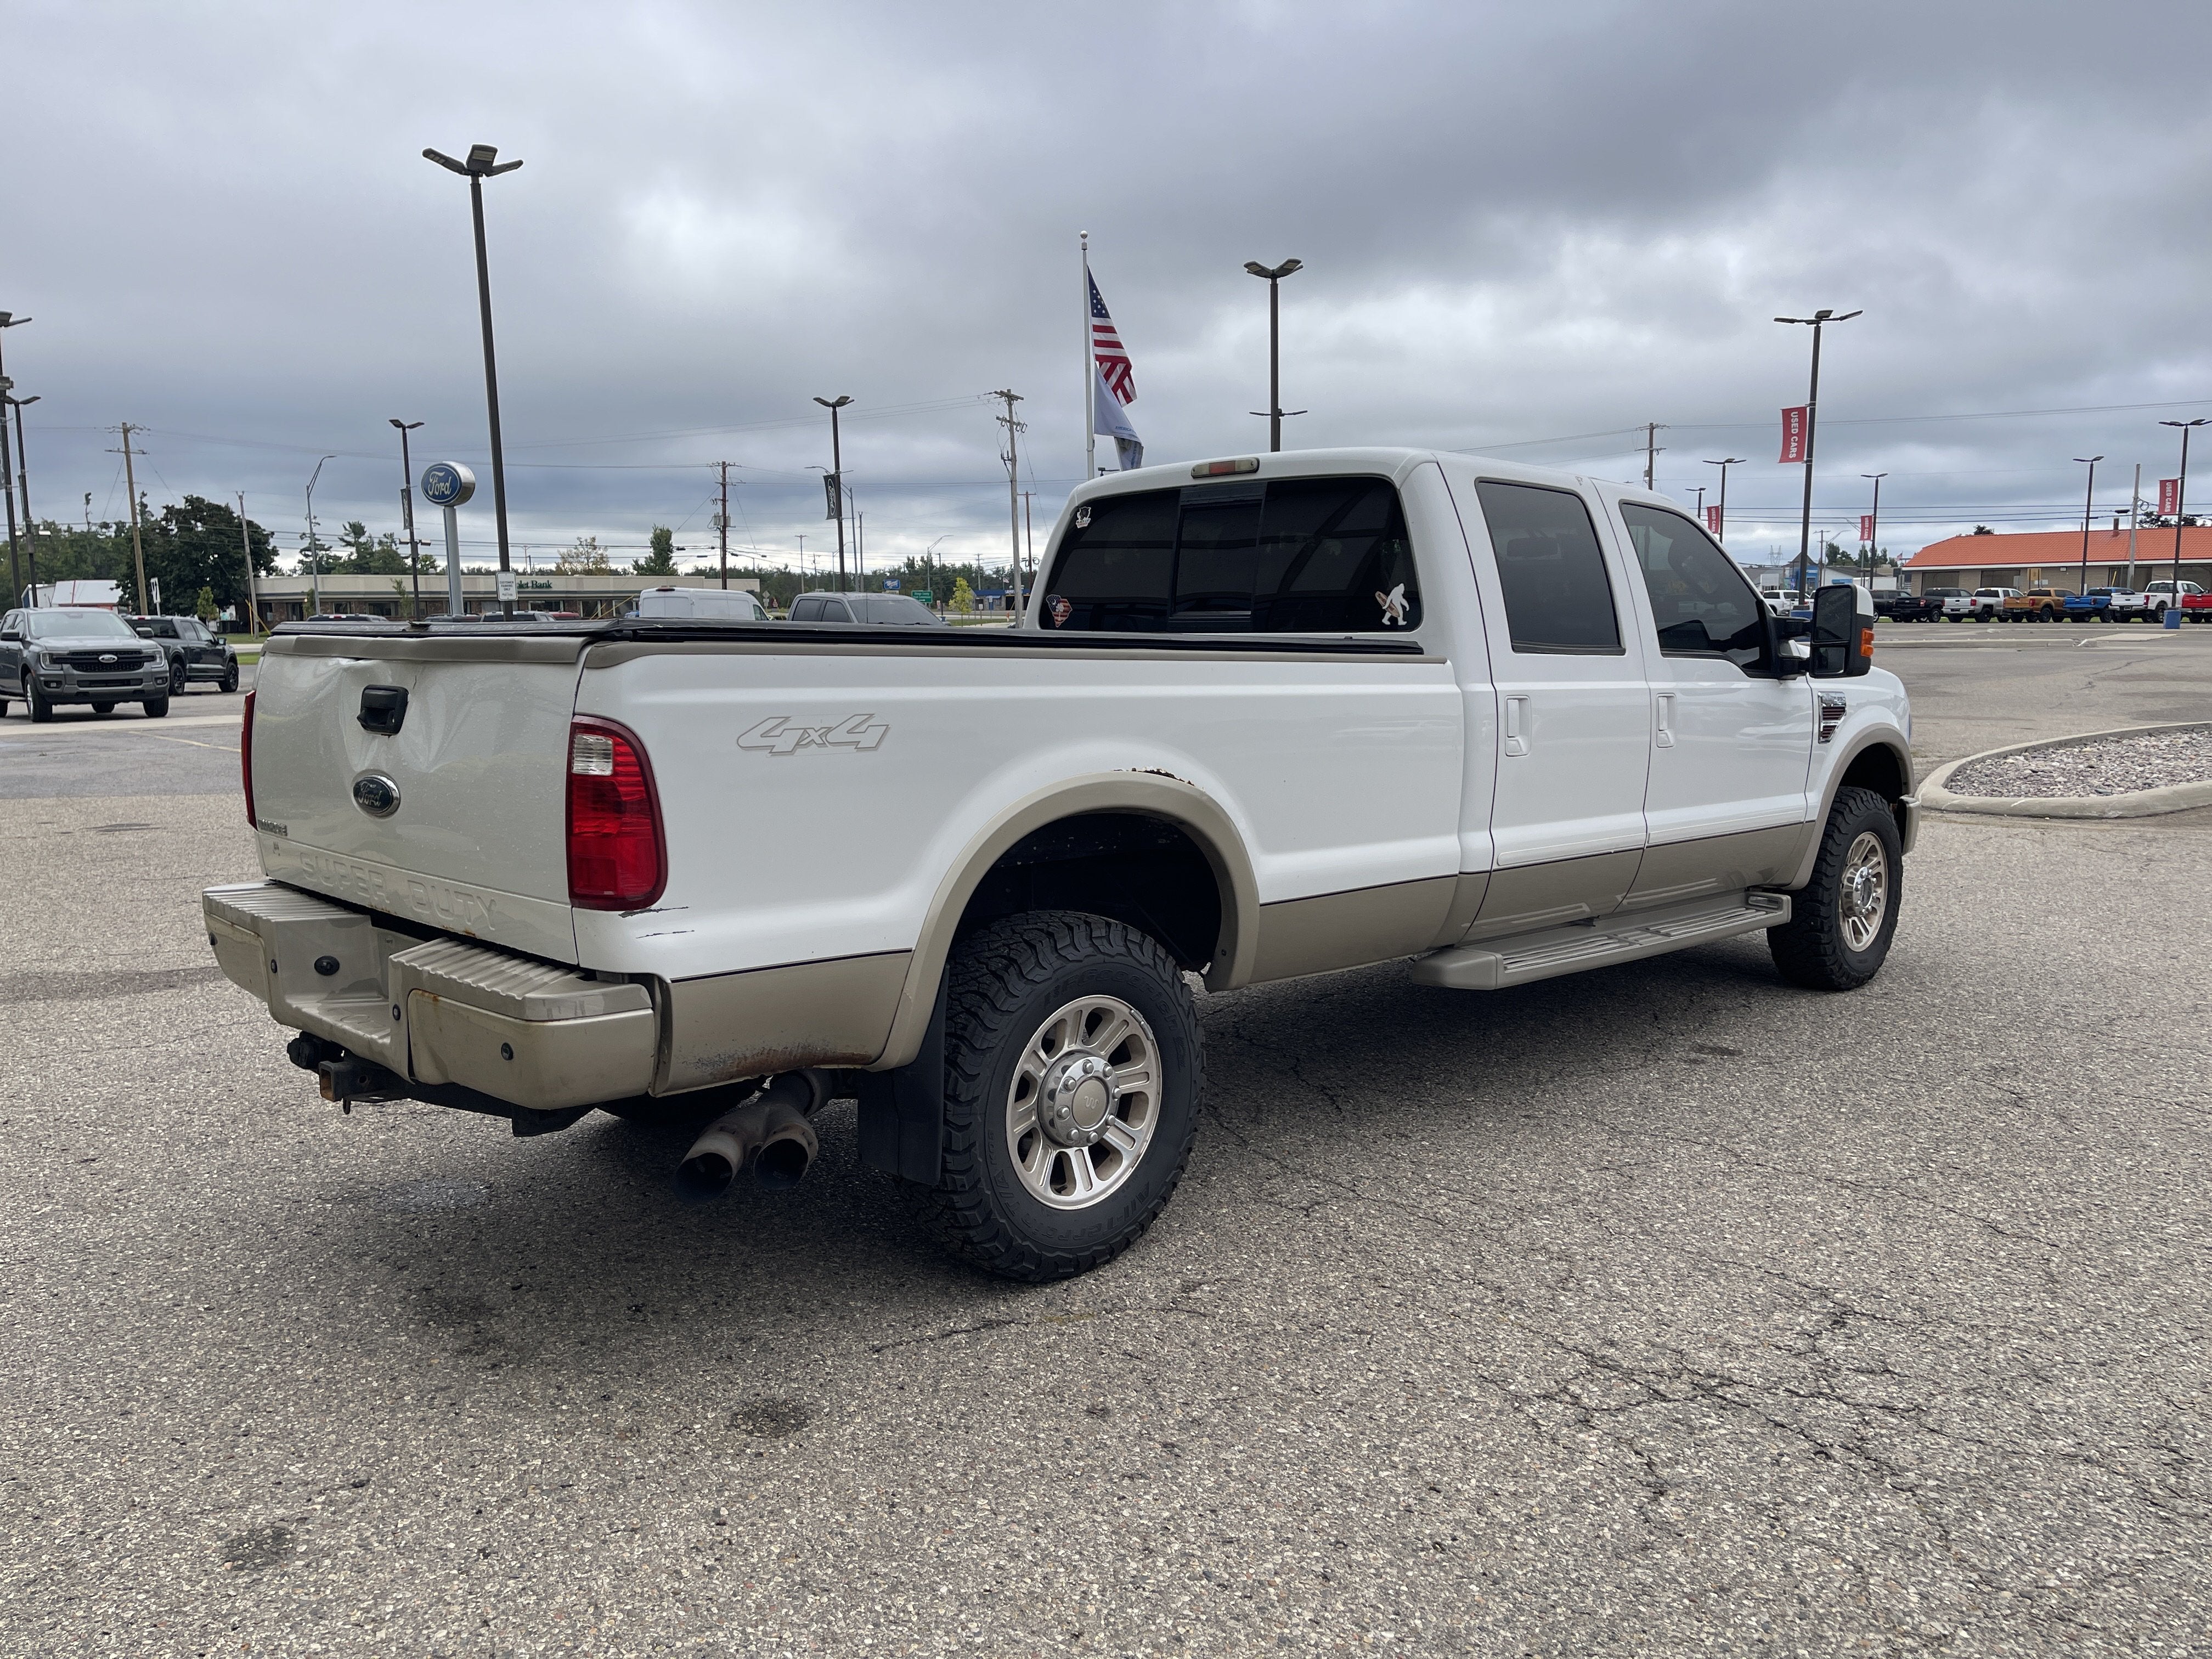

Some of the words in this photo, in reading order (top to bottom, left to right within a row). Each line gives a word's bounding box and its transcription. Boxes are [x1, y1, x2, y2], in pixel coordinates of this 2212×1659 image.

[1791, 411, 1799, 434] USED
[1789, 436, 1798, 459] CARS
[428, 471, 452, 496] Ford
[532, 580, 552, 589] Bank
[737, 714, 889, 756] 4x4
[358, 781, 381, 807] Ford
[302, 852, 390, 904] SUPER
[407, 879, 496, 930] DUTY
